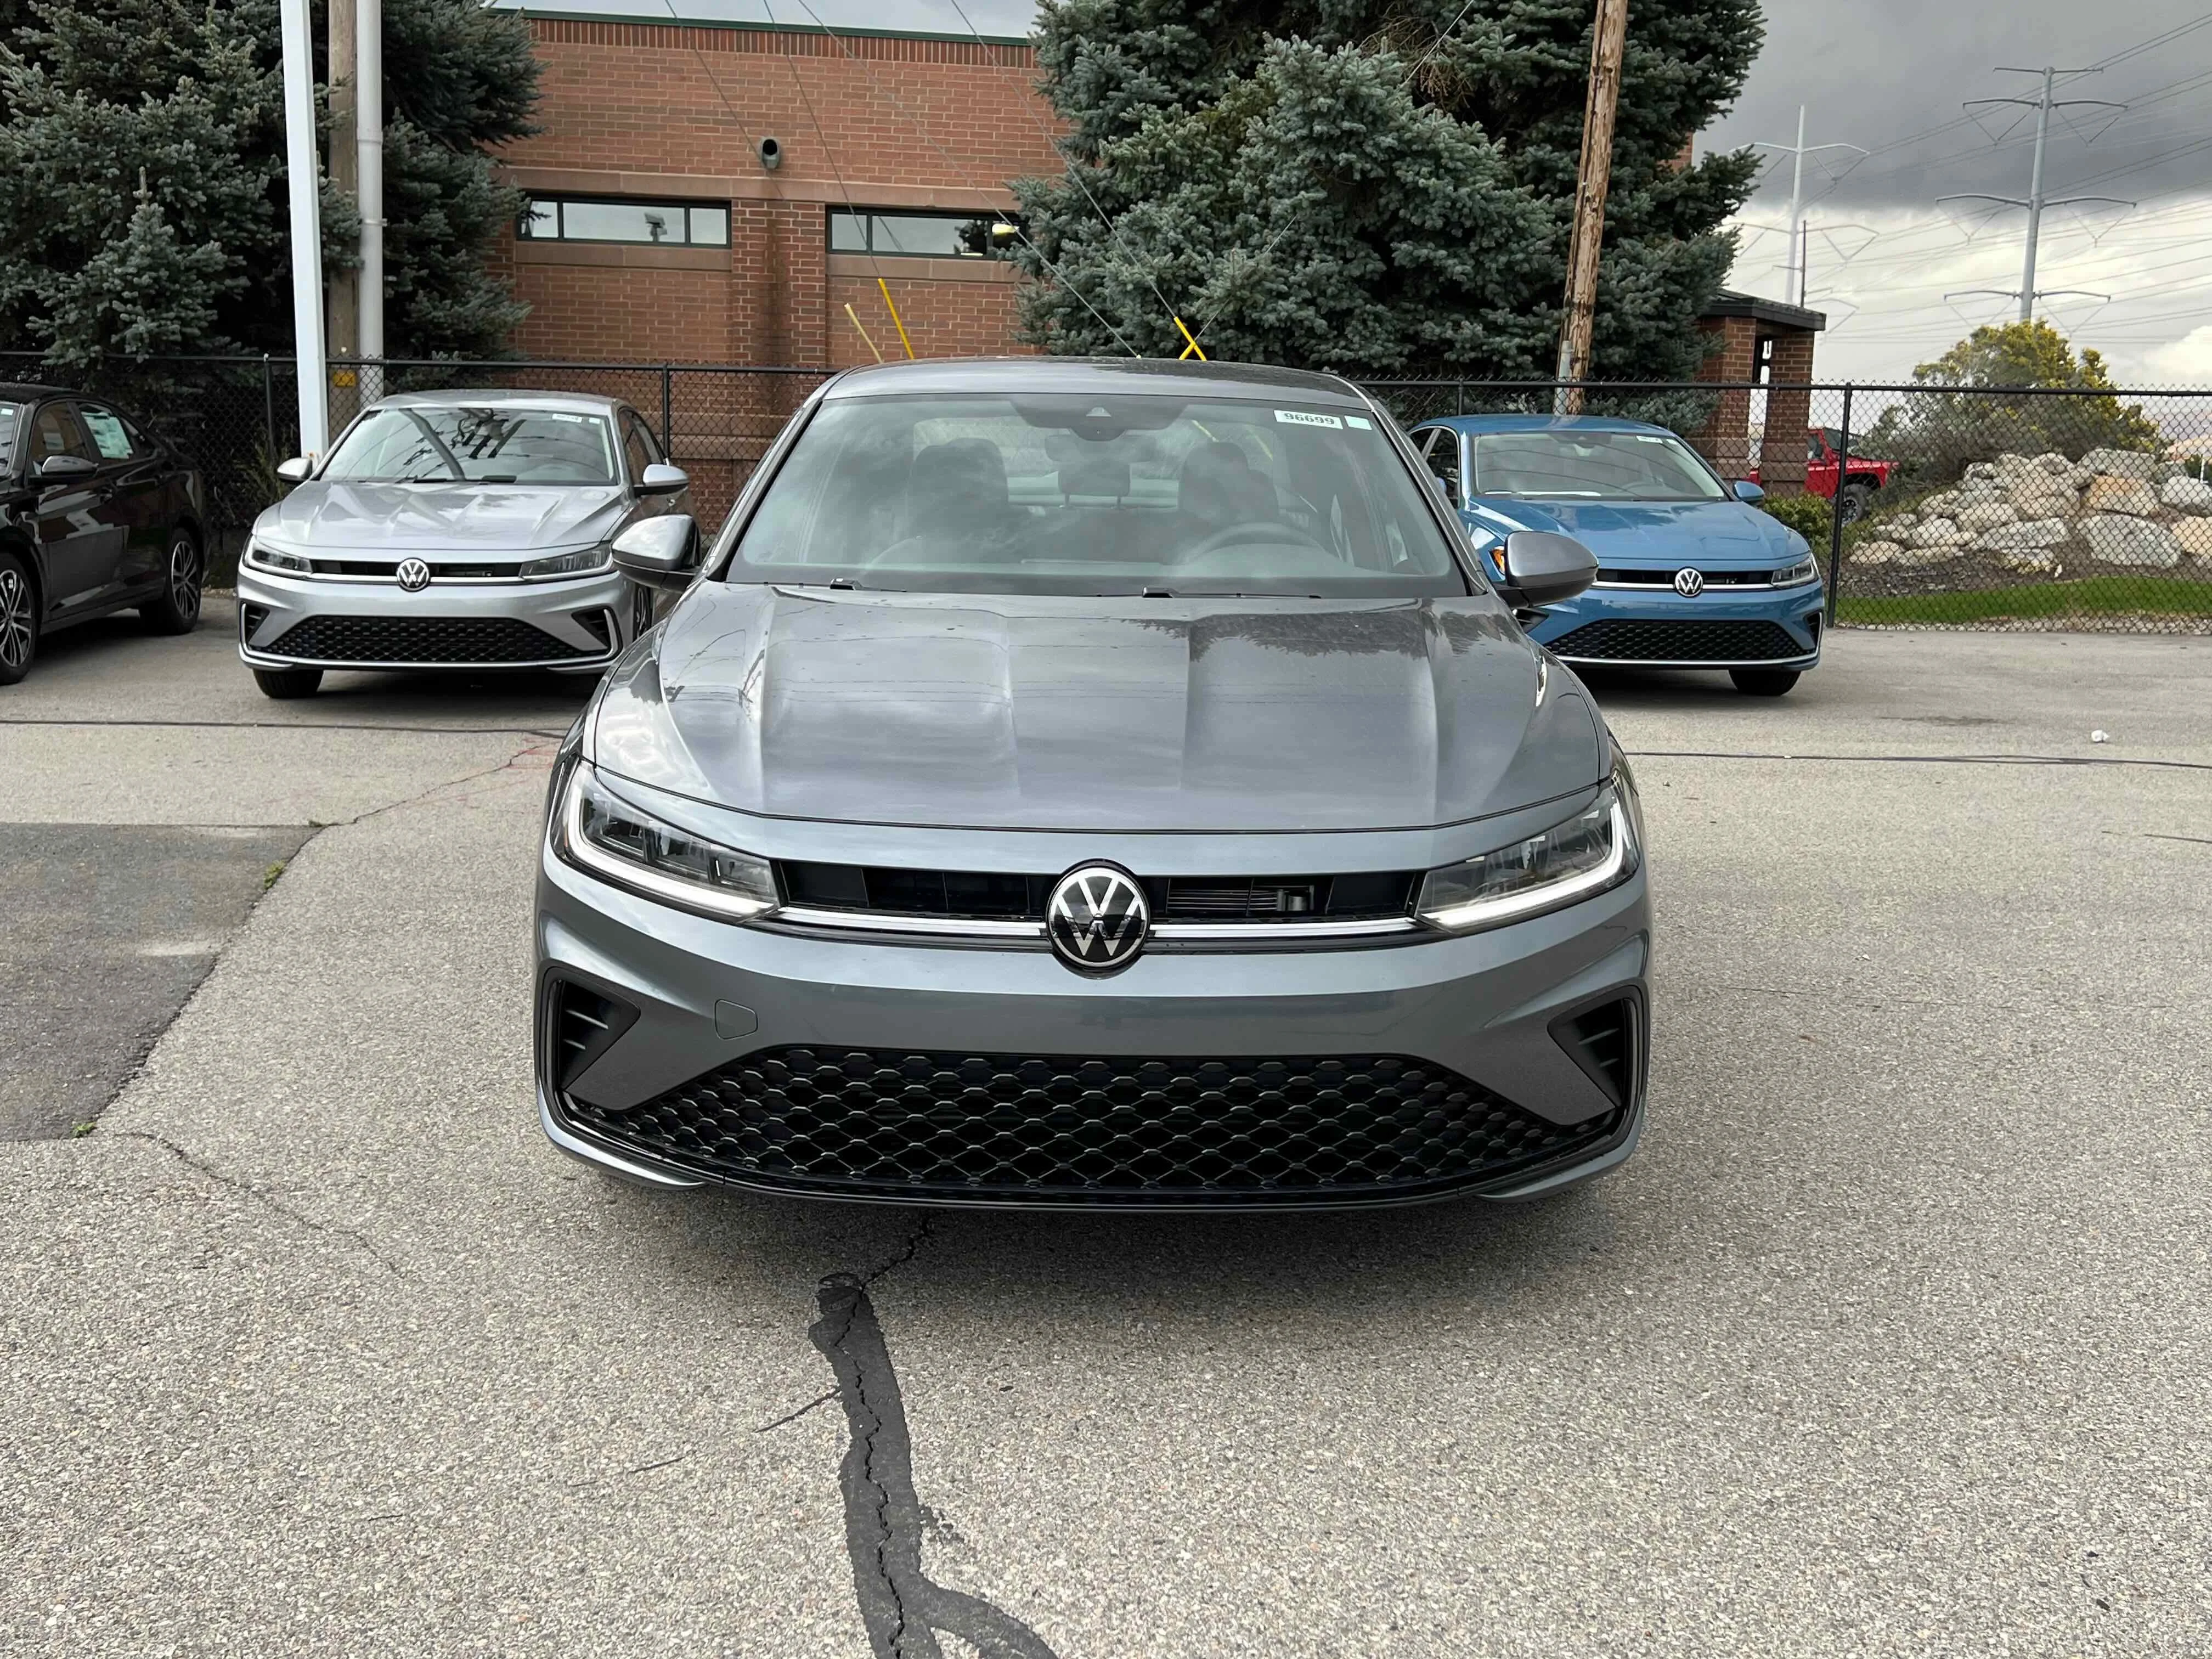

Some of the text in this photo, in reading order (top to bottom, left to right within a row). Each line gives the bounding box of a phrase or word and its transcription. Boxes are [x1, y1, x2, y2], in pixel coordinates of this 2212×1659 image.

[1284, 413, 1335, 425] 96699
[397, 559, 428, 590] VW
[1675, 568, 1703, 596] VW
[1050, 868, 1146, 966] VW
